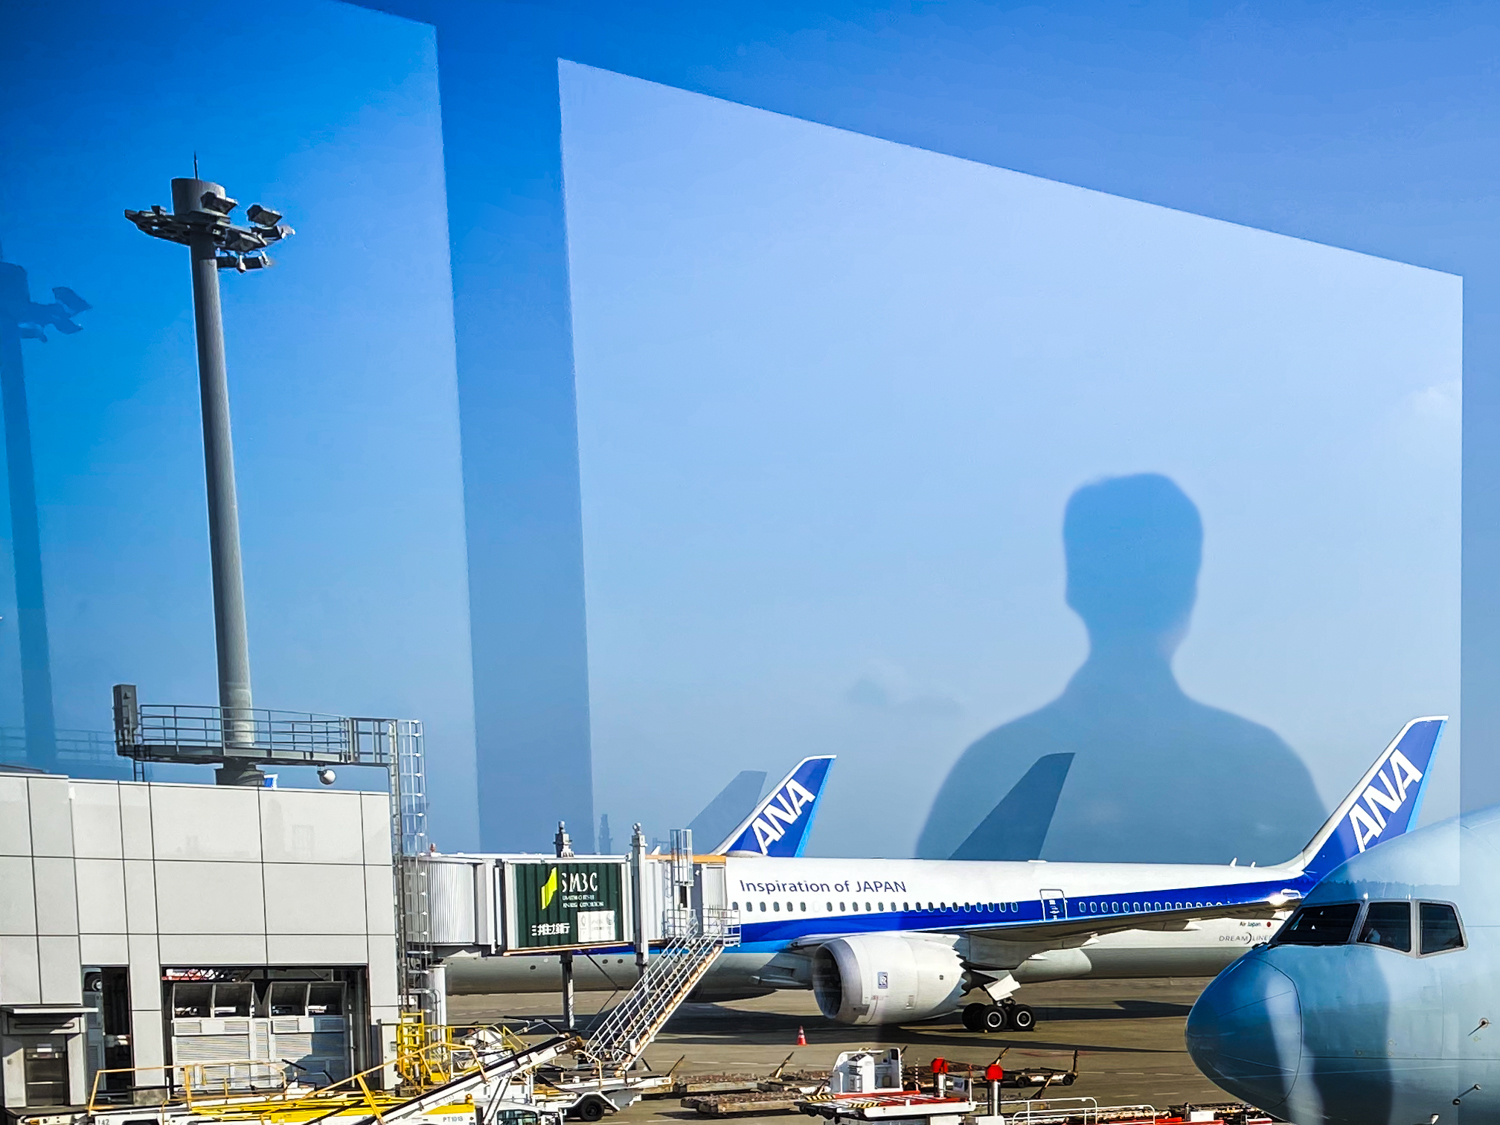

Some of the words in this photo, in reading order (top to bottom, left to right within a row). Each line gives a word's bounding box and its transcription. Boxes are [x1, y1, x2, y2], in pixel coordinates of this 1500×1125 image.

[751, 778, 816, 856] ANA
[1349, 748, 1423, 853] ANA
[739, 879, 830, 896] Inspiration
[834, 880, 851, 893] of
[855, 880, 907, 893] JAPAN
